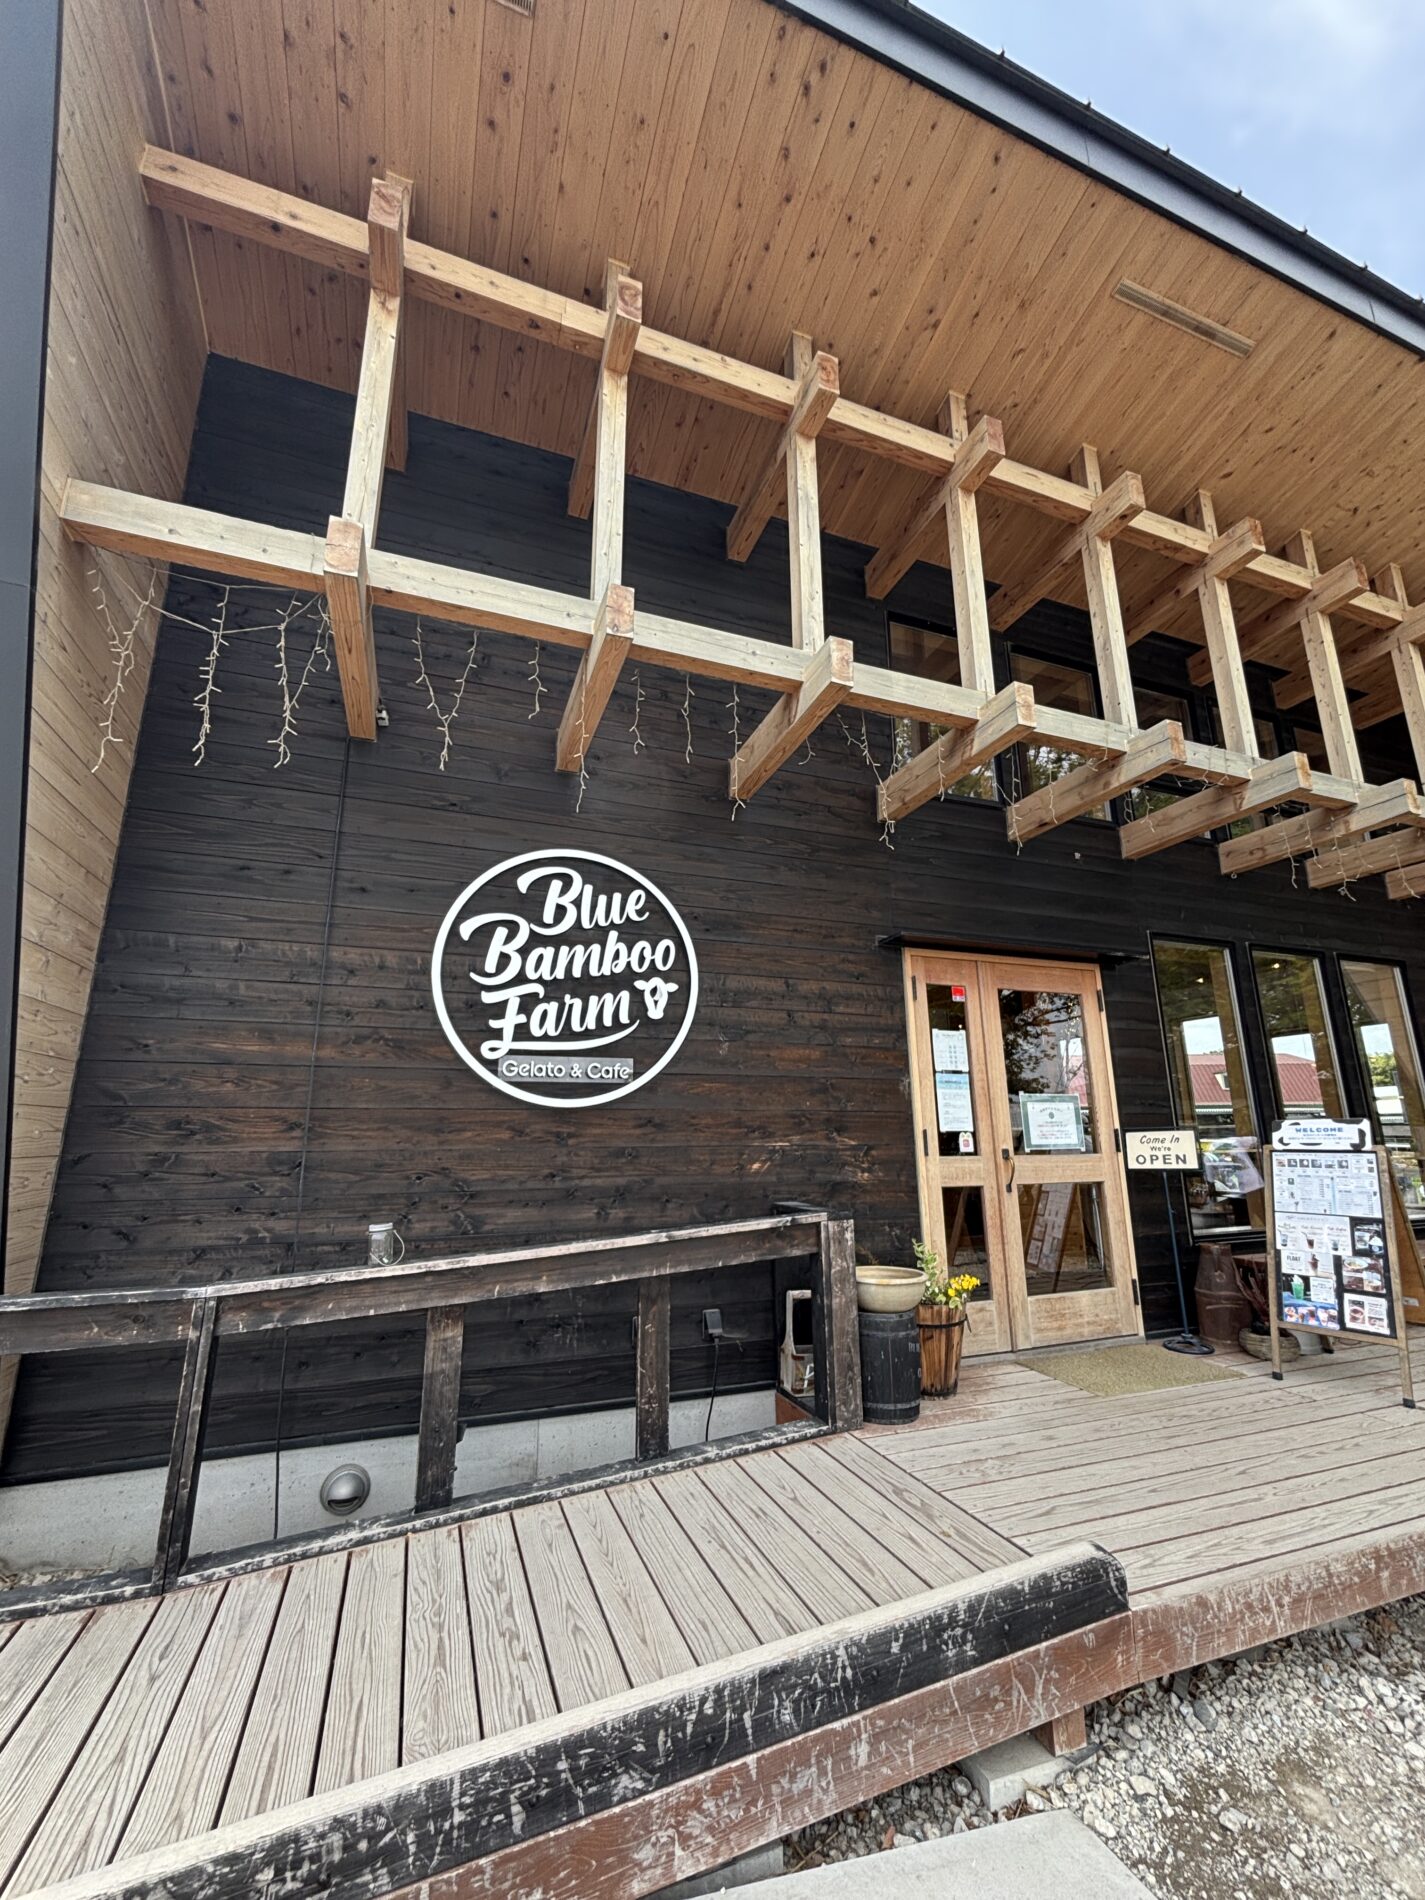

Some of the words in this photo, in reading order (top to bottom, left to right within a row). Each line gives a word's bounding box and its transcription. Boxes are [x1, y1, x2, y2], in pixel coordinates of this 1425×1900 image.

[516, 866, 650, 936] Blue
[459, 912, 676, 985] Bamboo
[480, 982, 640, 1060] Farm
[502, 1060, 566, 1077] Gelato
[571, 1063, 582, 1078] &
[586, 1062, 631, 1079] Cafe
[1135, 1153, 1187, 1165] OPEN
[1139, 1134, 1167, 1145] Come
[1169, 1134, 1180, 1144] In
